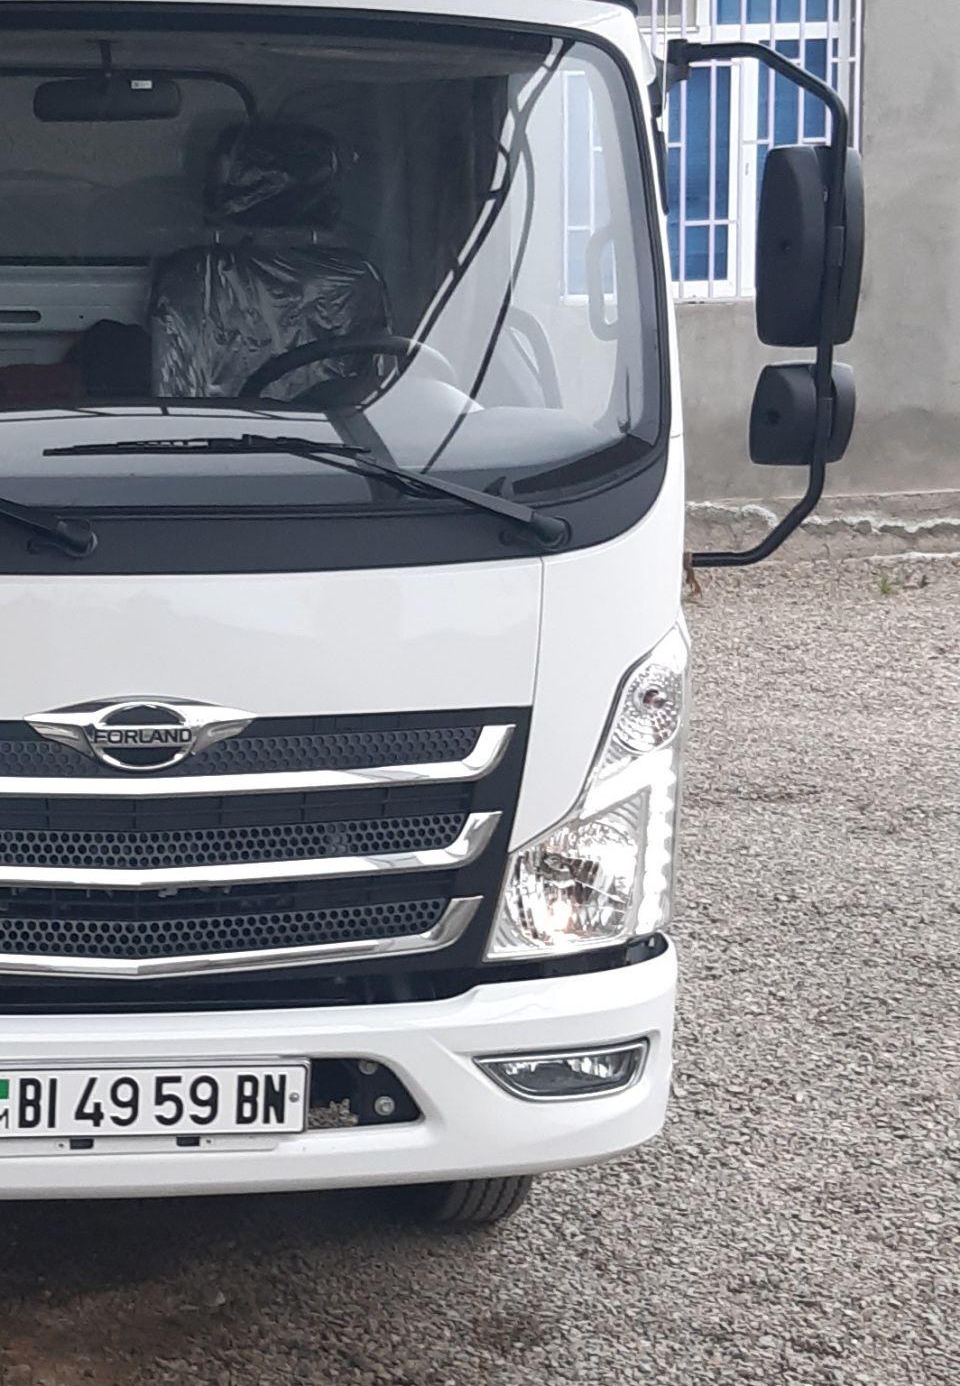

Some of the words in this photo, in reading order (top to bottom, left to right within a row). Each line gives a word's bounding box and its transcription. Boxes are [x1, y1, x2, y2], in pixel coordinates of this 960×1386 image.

[93, 728, 192, 745] FORLAND
[18, 1077, 57, 1129] BI
[235, 1074, 287, 1125] BN
